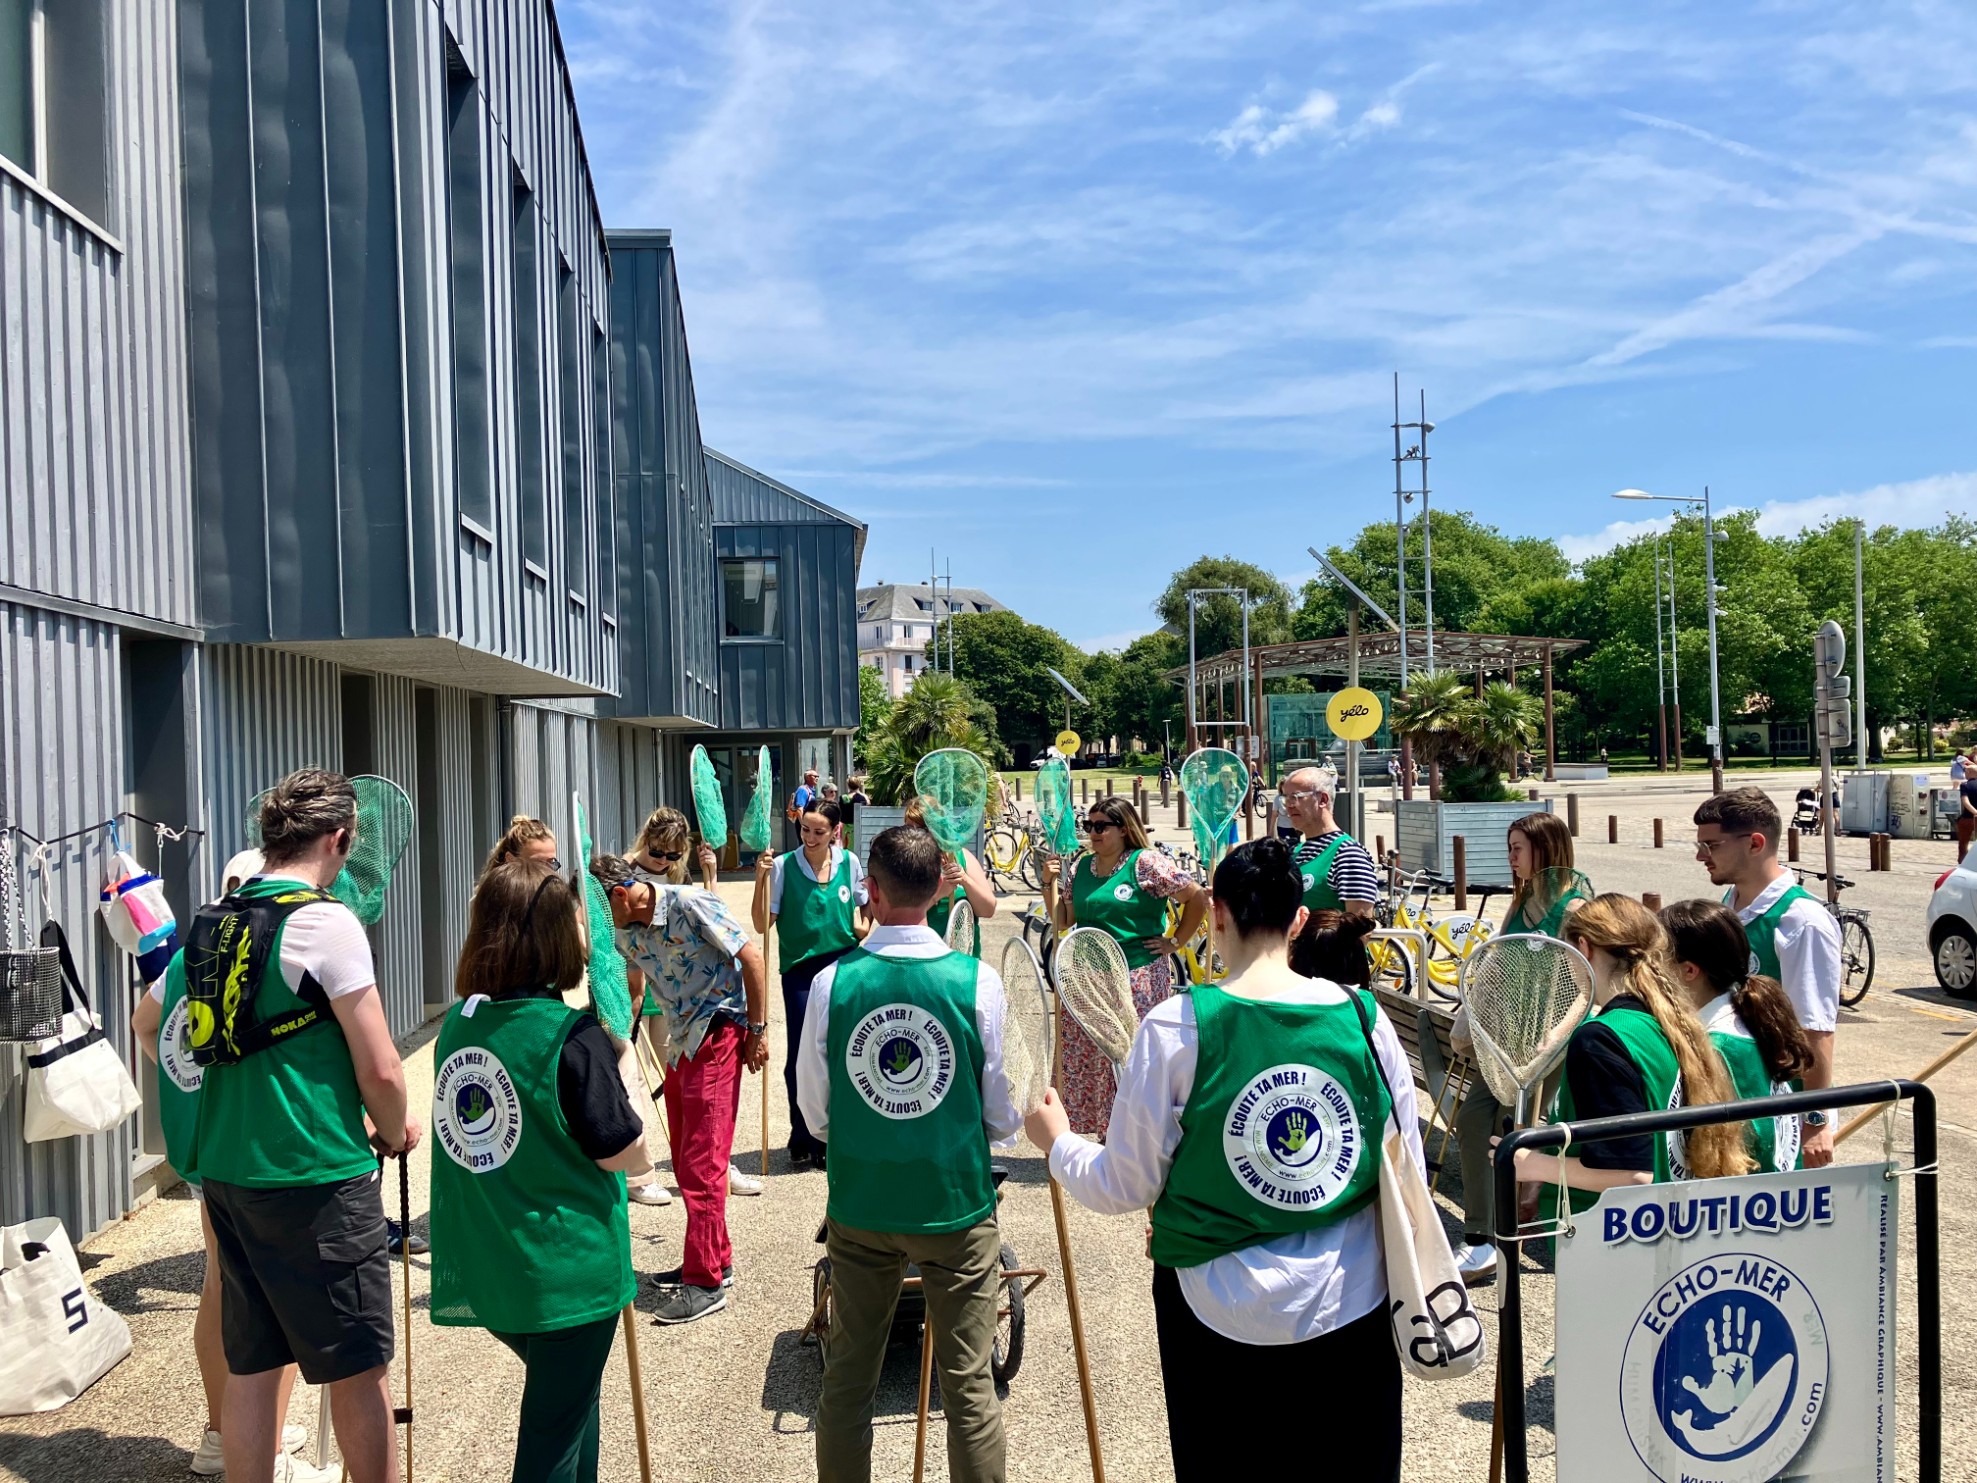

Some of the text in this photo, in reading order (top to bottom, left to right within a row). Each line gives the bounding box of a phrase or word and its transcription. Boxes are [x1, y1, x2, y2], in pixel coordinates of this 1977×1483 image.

[1340, 705, 1369, 722] yélo
[270, 1017, 306, 1036] HOKA
[850, 1021, 875, 1058] ÉCOUTE
[872, 1014, 886, 1026] TA
[876, 1029, 920, 1047] ECHO-MER
[924, 1019, 950, 1056] ÉCOUTE
[940, 1058, 950, 1070] TA
[436, 1064, 454, 1102] ÉCOUTE
[453, 1056, 464, 1070] TA
[454, 1074, 493, 1092] ECHO-MER
[495, 1068, 516, 1110] ÉCOUTE
[508, 1112, 518, 1124] TA
[1228, 1090, 1260, 1137] ÉCOUTE
[1255, 1078, 1272, 1094] TA
[1261, 1096, 1316, 1122] ECHO-MER
[1320, 1082, 1352, 1126] ÉCOUTE
[1342, 1128, 1354, 1143] TA
[1260, 1181, 1277, 1199] TA
[1278, 1184, 1326, 1204] ÉCOUTE
[1603, 1186, 1832, 1242] BOUTIQUE
[1642, 1260, 1791, 1336] ECHO-MER
